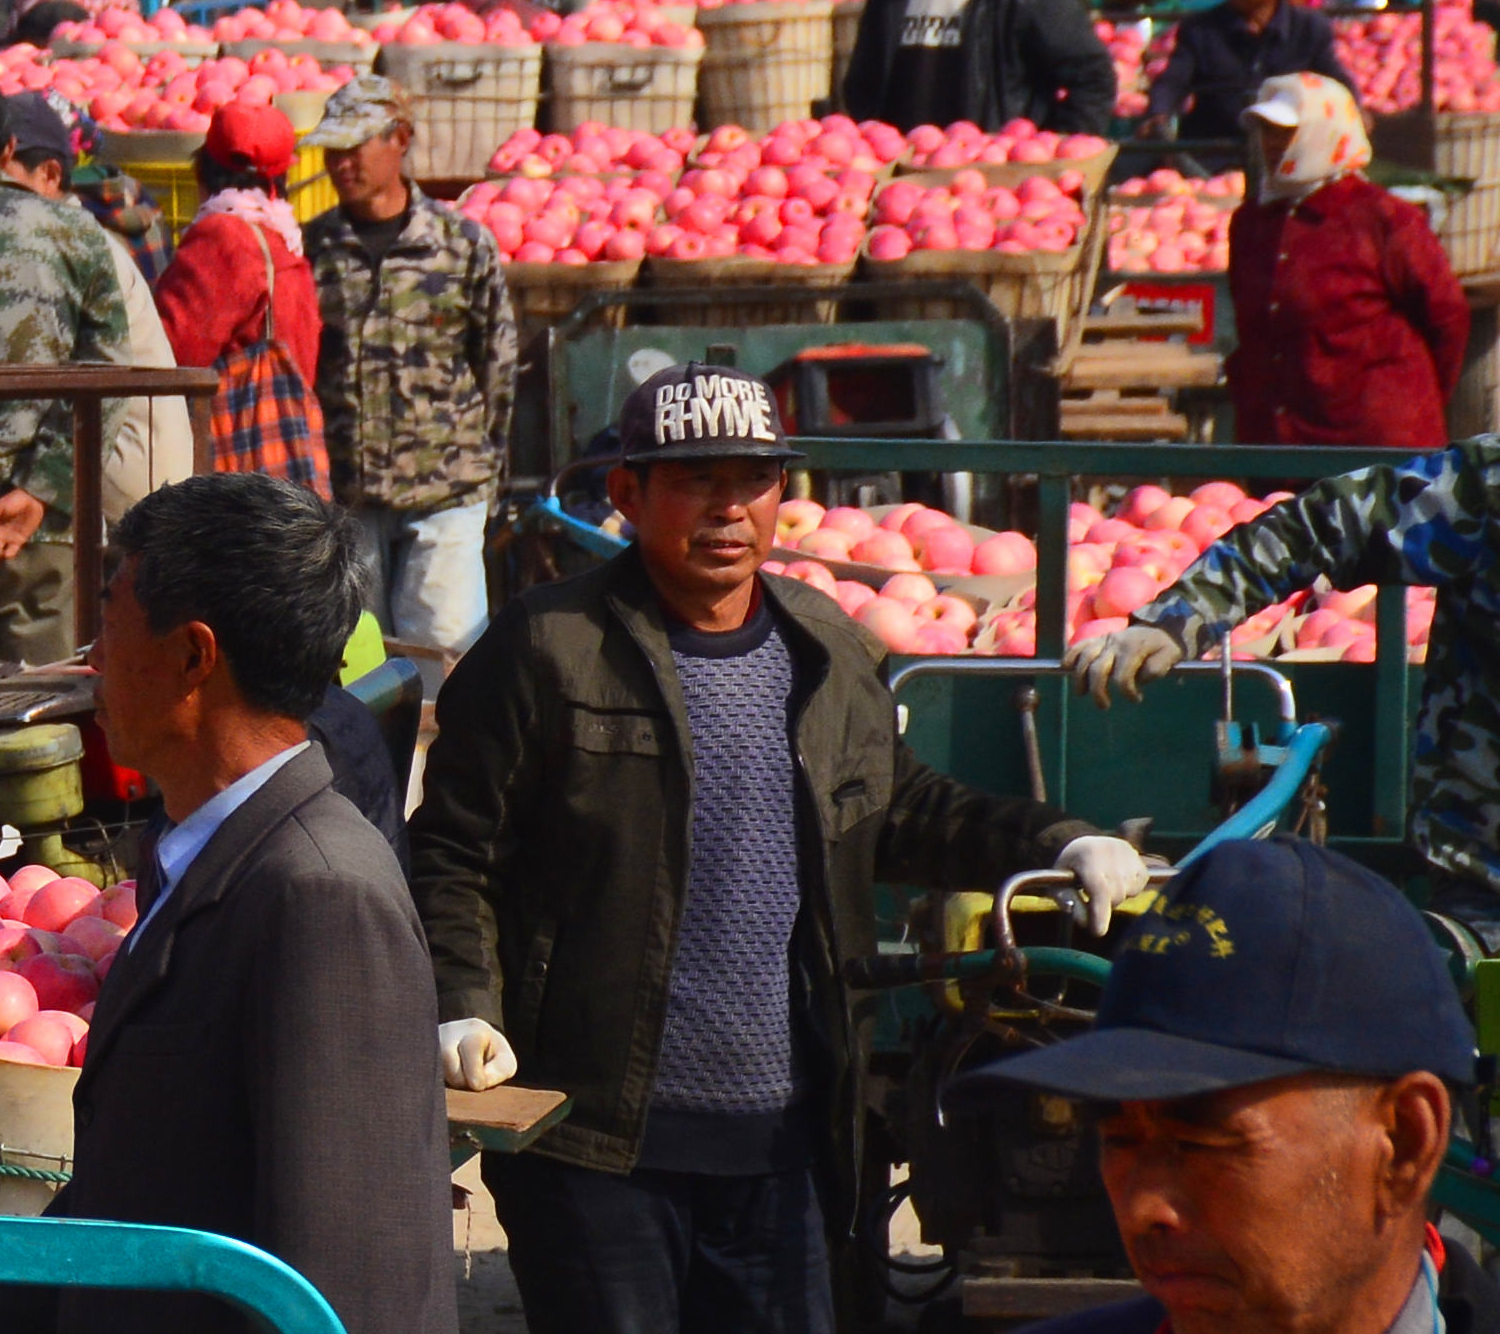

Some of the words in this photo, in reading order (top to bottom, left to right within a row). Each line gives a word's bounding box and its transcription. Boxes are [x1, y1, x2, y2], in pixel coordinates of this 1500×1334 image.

[656, 383, 692, 407] DO
[694, 374, 769, 406] MORE
[655, 396, 777, 446] RHYME
